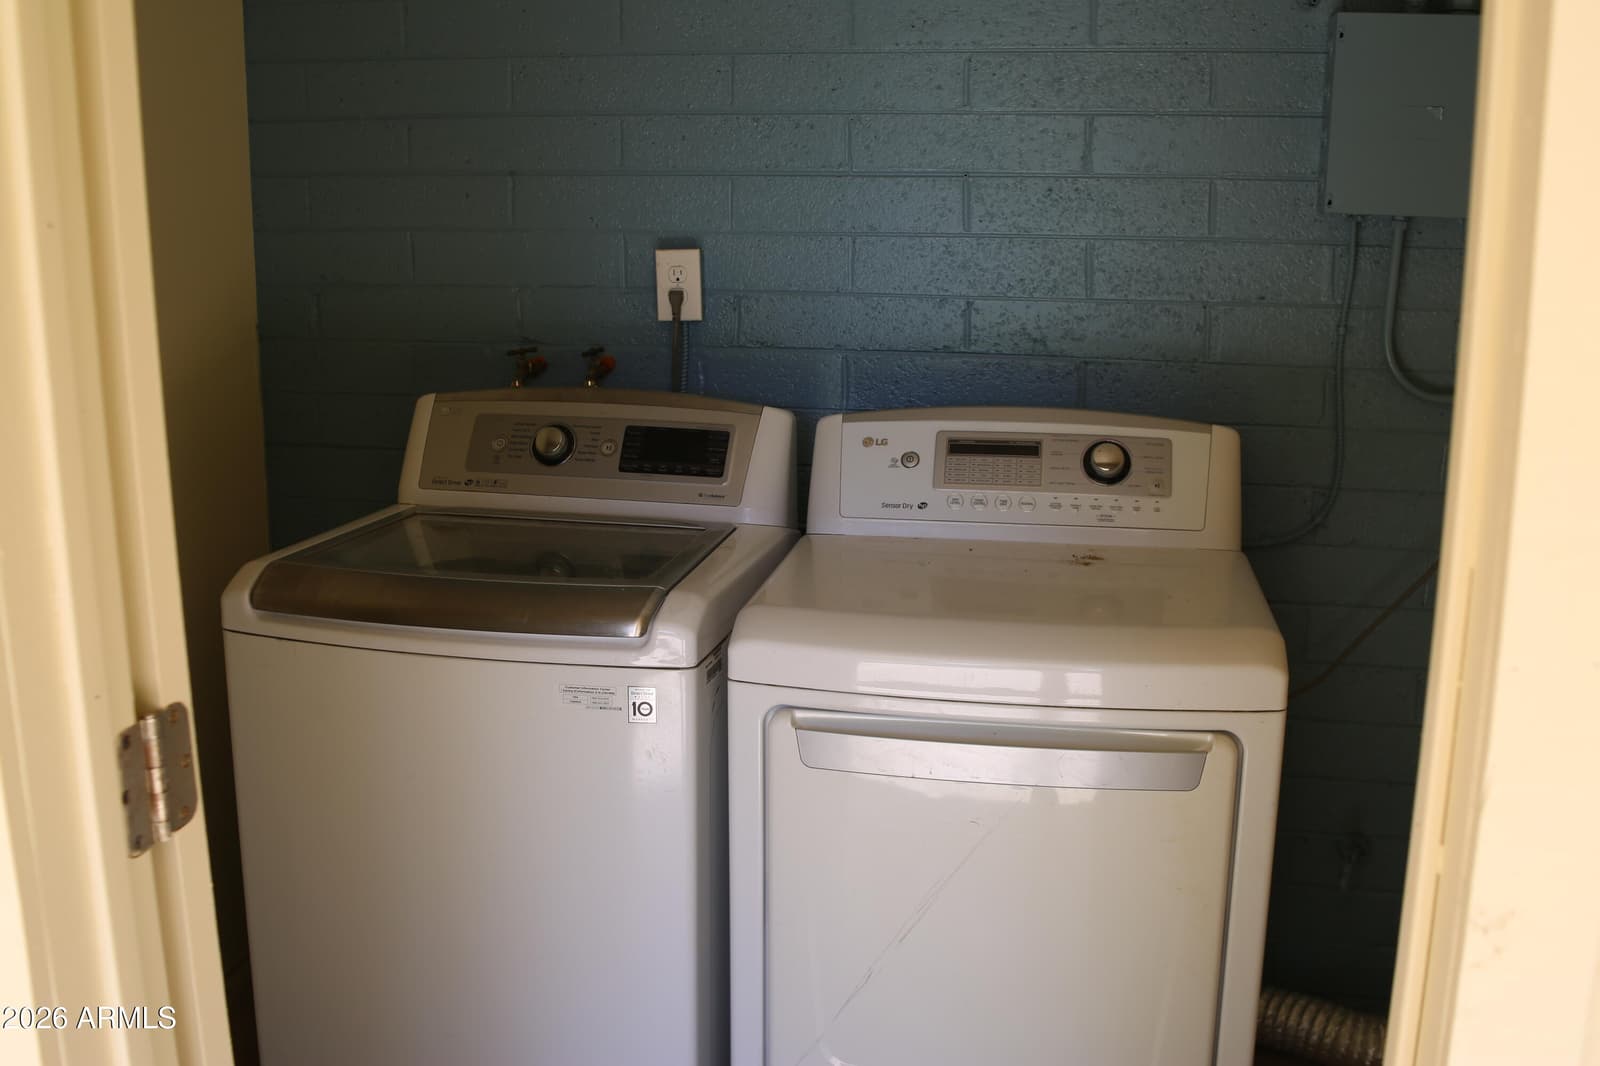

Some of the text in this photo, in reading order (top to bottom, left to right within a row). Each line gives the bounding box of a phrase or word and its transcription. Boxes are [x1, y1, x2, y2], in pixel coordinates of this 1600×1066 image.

[875, 438, 888, 446] LG
[902, 502, 914, 510] Dry
[632, 701, 653, 717] 10
